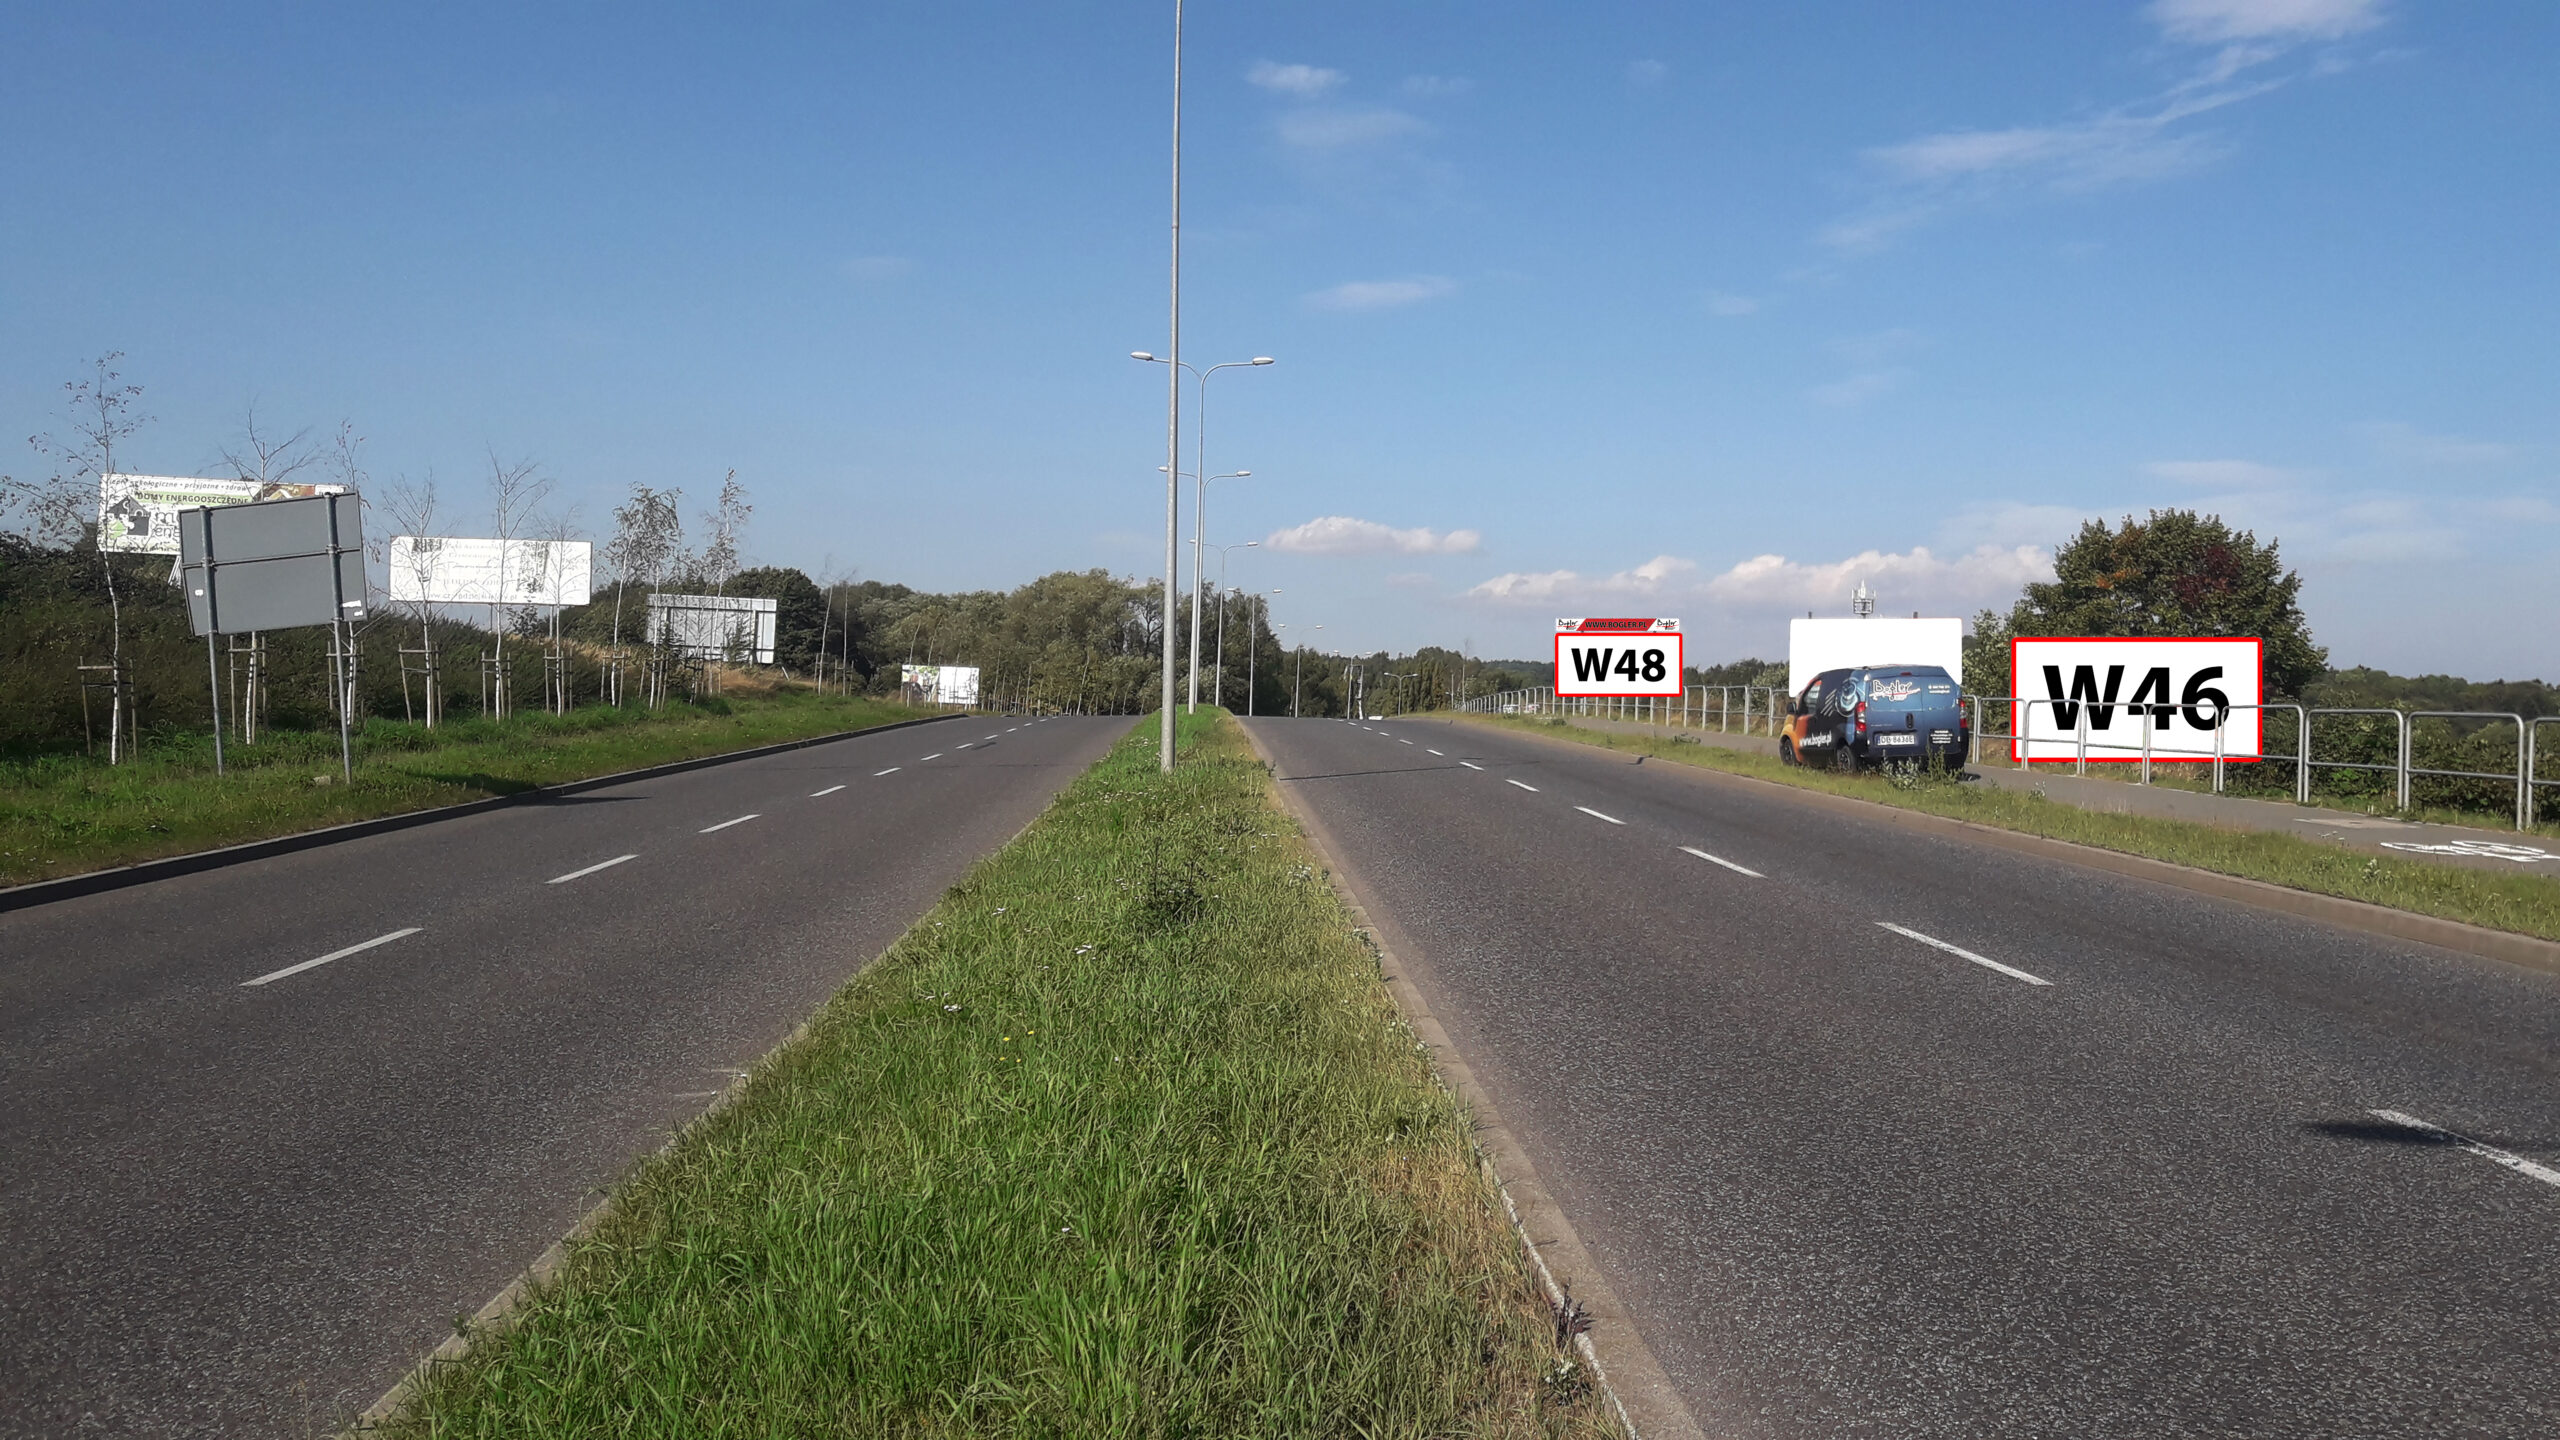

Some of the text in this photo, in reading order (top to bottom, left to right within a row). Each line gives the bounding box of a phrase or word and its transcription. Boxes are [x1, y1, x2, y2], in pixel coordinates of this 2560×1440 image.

[1571, 648, 1666, 682] W48
[1873, 680, 1912, 700] Bogler
[2042, 665, 2230, 731] W46
[1799, 730, 1832, 747] www.bogler.pl
